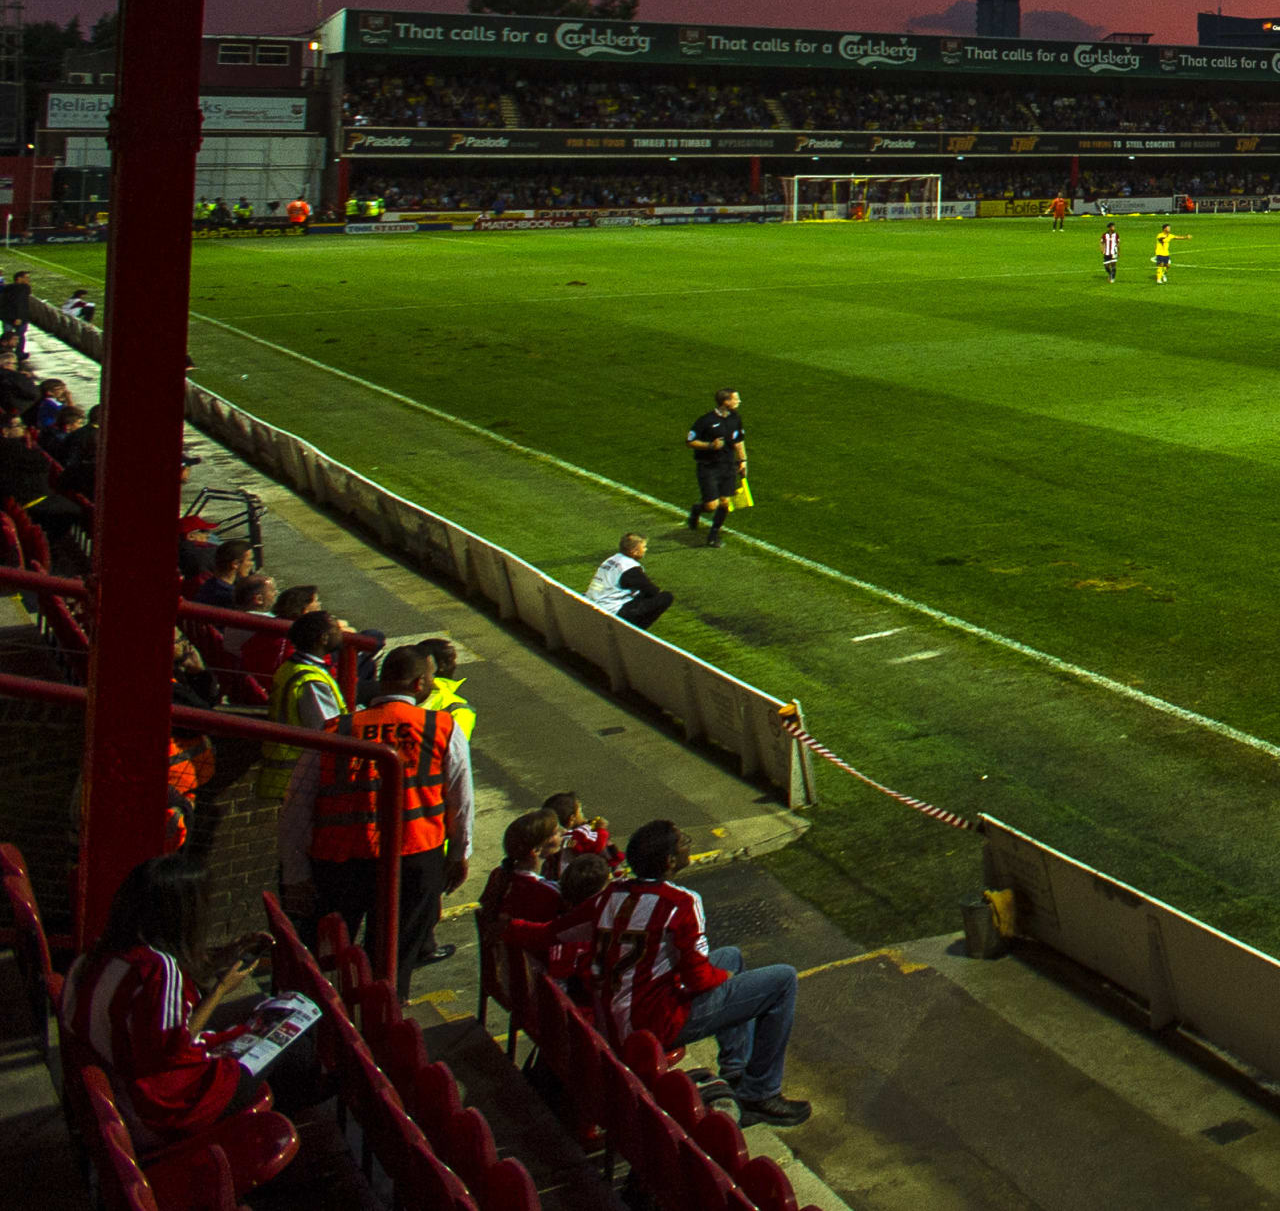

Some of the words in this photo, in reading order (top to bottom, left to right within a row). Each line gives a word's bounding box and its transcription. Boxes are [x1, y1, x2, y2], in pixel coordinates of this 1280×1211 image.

[394, 22, 444, 40] That
[450, 25, 496, 42] calls
[501, 27, 530, 43] for
[535, 32, 548, 44] a
[555, 22, 651, 57] Carlsberg
[707, 35, 749, 51] That
[752, 37, 789, 53] calls
[795, 39, 817, 54] for
[822, 43, 832, 54] a
[838, 35, 917, 65] Carlsberg
[964, 46, 998, 60] That
[1001, 48, 1033, 61] calls
[1036, 49, 1056, 62] for
[1060, 54, 1068, 63] a
[1074, 44, 1140, 73] Carlsberg
[1179, 54, 1207, 68] That
[1210, 56, 1237, 69] calls
[1240, 57, 1257, 69] for
[1260, 61, 1267, 69] a
[50, 97, 110, 111] Reliab
[365, 135, 413, 147] Paslode
[465, 136, 511, 148] Paslode
[632, 138, 665, 148] TIMBER
[667, 138, 678, 148] TO
[680, 138, 712, 148] TIMBER
[363, 722, 412, 740] BFC
